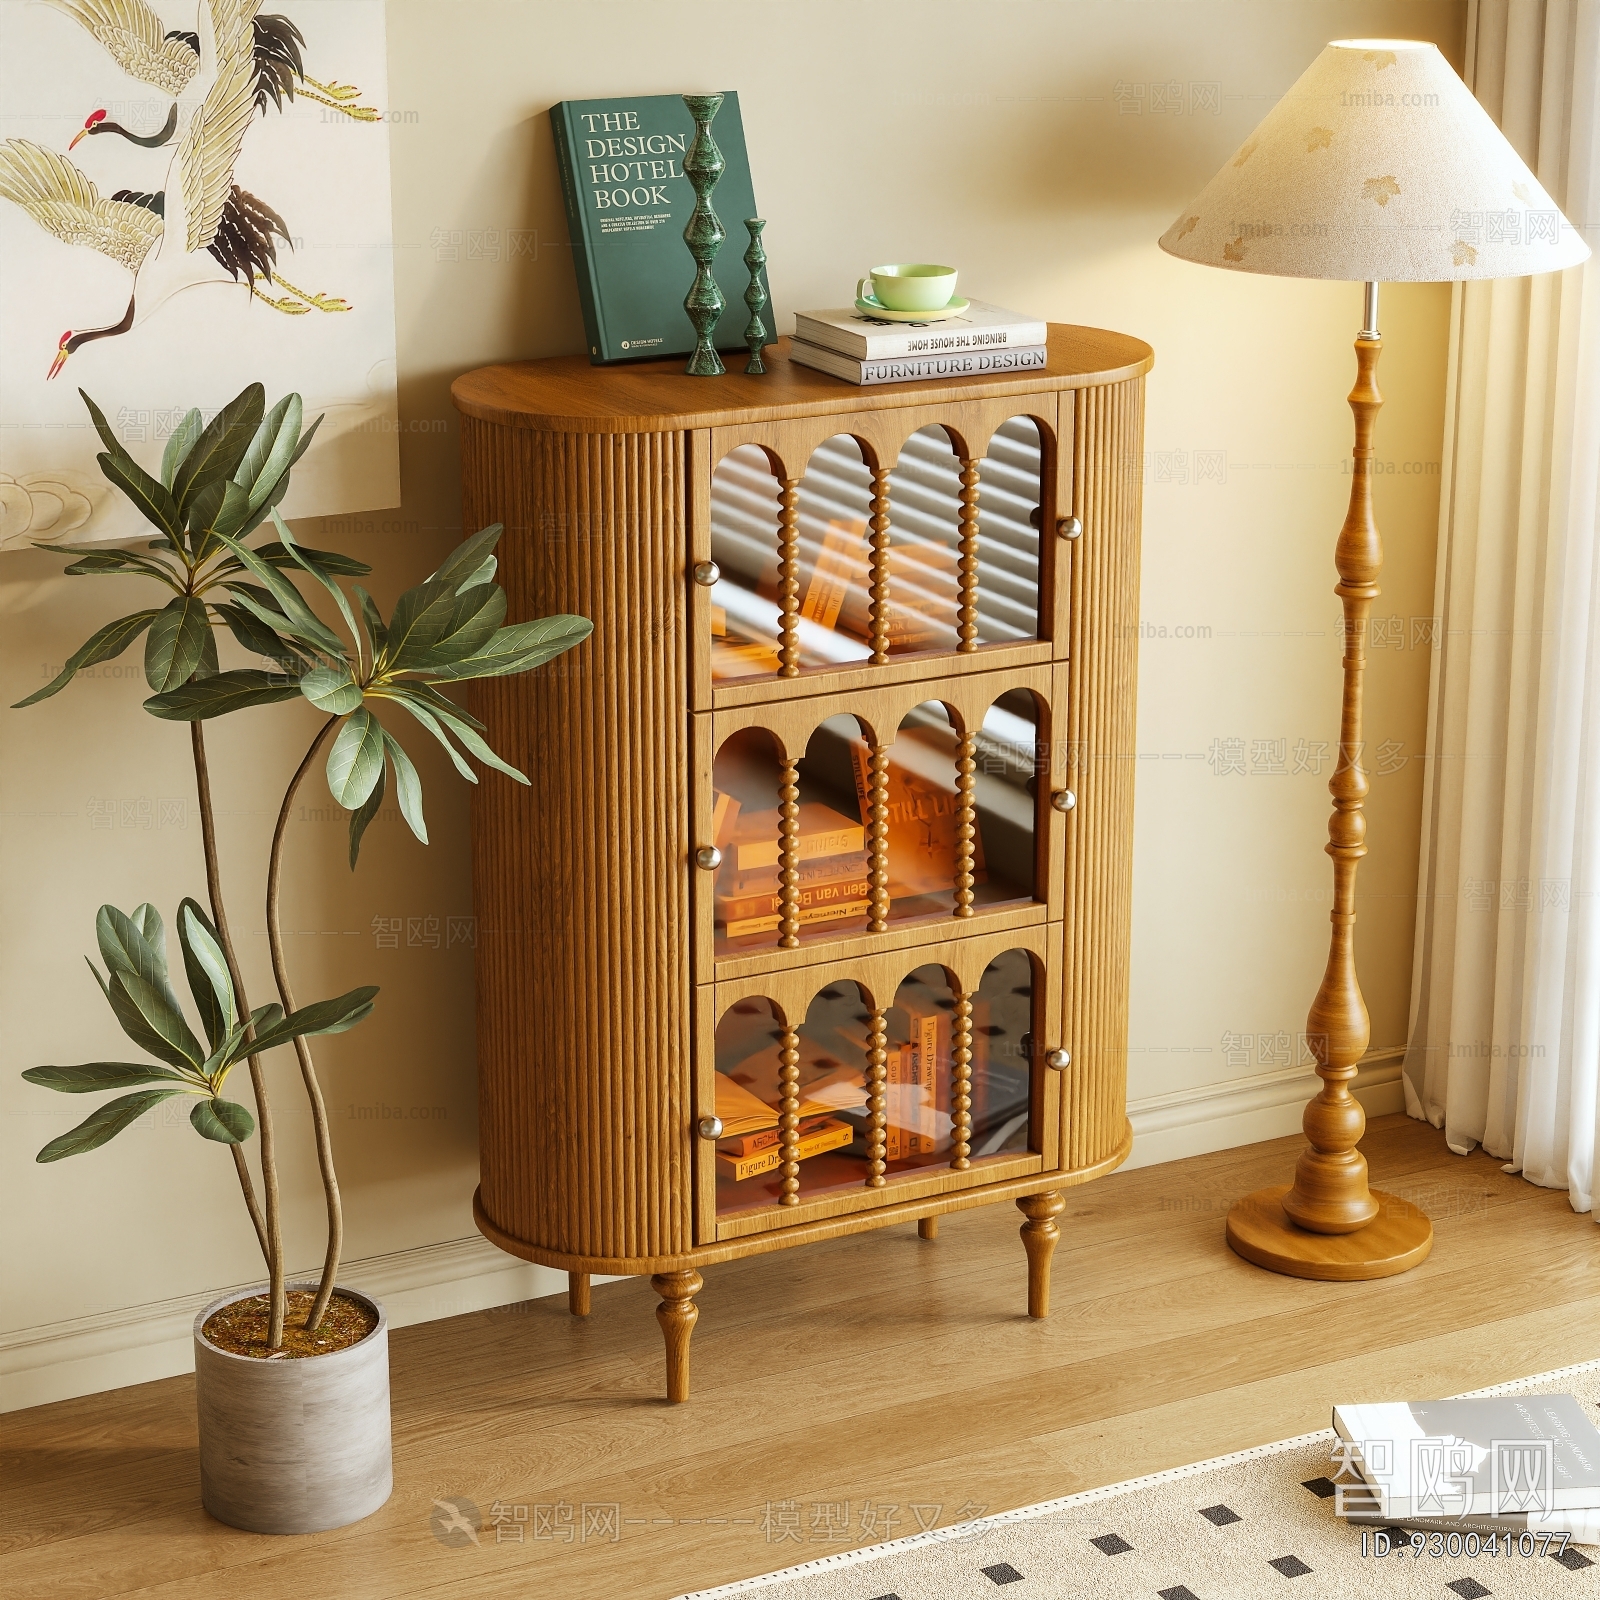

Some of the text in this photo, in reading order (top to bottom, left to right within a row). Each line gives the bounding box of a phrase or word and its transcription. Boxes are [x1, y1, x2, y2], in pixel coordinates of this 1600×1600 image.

[581, 111, 641, 133] THE
[585, 133, 686, 159] DESIGN
[589, 159, 686, 184] HOTEL
[593, 185, 671, 209] BOOK
[907, 331, 1007, 352] BRINGING THE HOUSE HOME
[864, 350, 1046, 382] FURNITURE DESIGN
[852, 754, 866, 801] STILL LIFE
[888, 799, 929, 825] TILL
[771, 882, 868, 912] Ben van Beel
[924, 1021, 936, 1051] Figure
[740, 1160, 766, 1176] Figure
[1565, 1439, 1595, 1473] LANDMARK
[1406, 1516, 1443, 1525] LANDMARK
[1445, 1520, 1461, 1528] AND
[1462, 1522, 1517, 1533] ARCHITECTURAL
